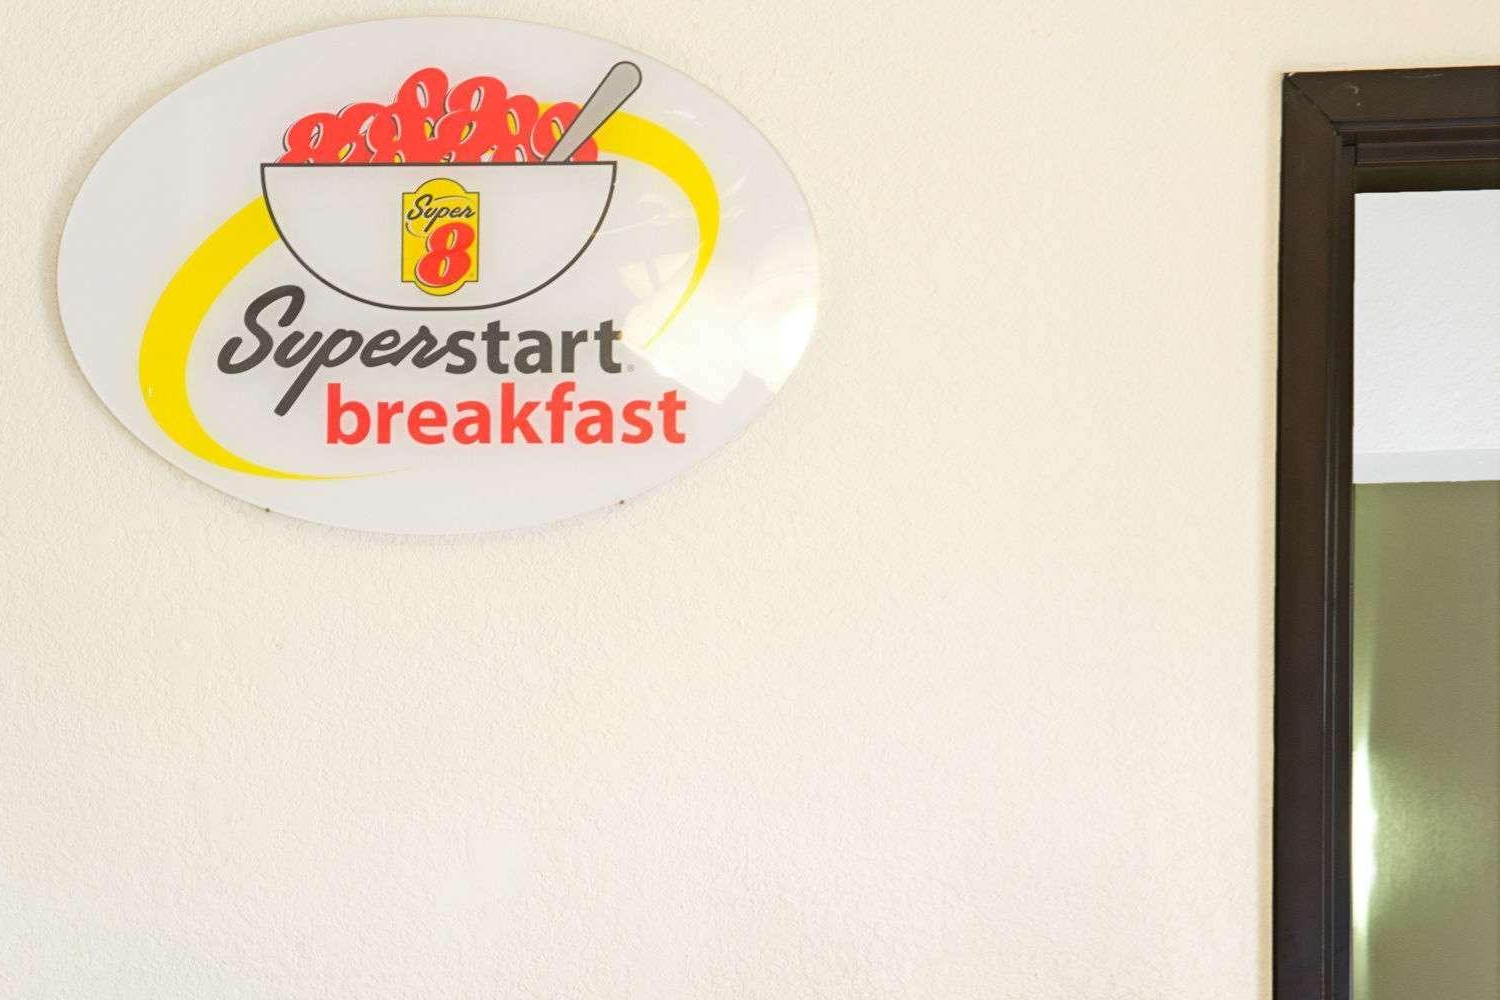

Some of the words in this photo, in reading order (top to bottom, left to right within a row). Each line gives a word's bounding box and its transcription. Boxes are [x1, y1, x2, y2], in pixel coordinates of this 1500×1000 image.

[406, 193, 475, 233] Super
[414, 221, 476, 289] 8
[217, 284, 622, 416] Superstart
[326, 382, 687, 446] breakfast
